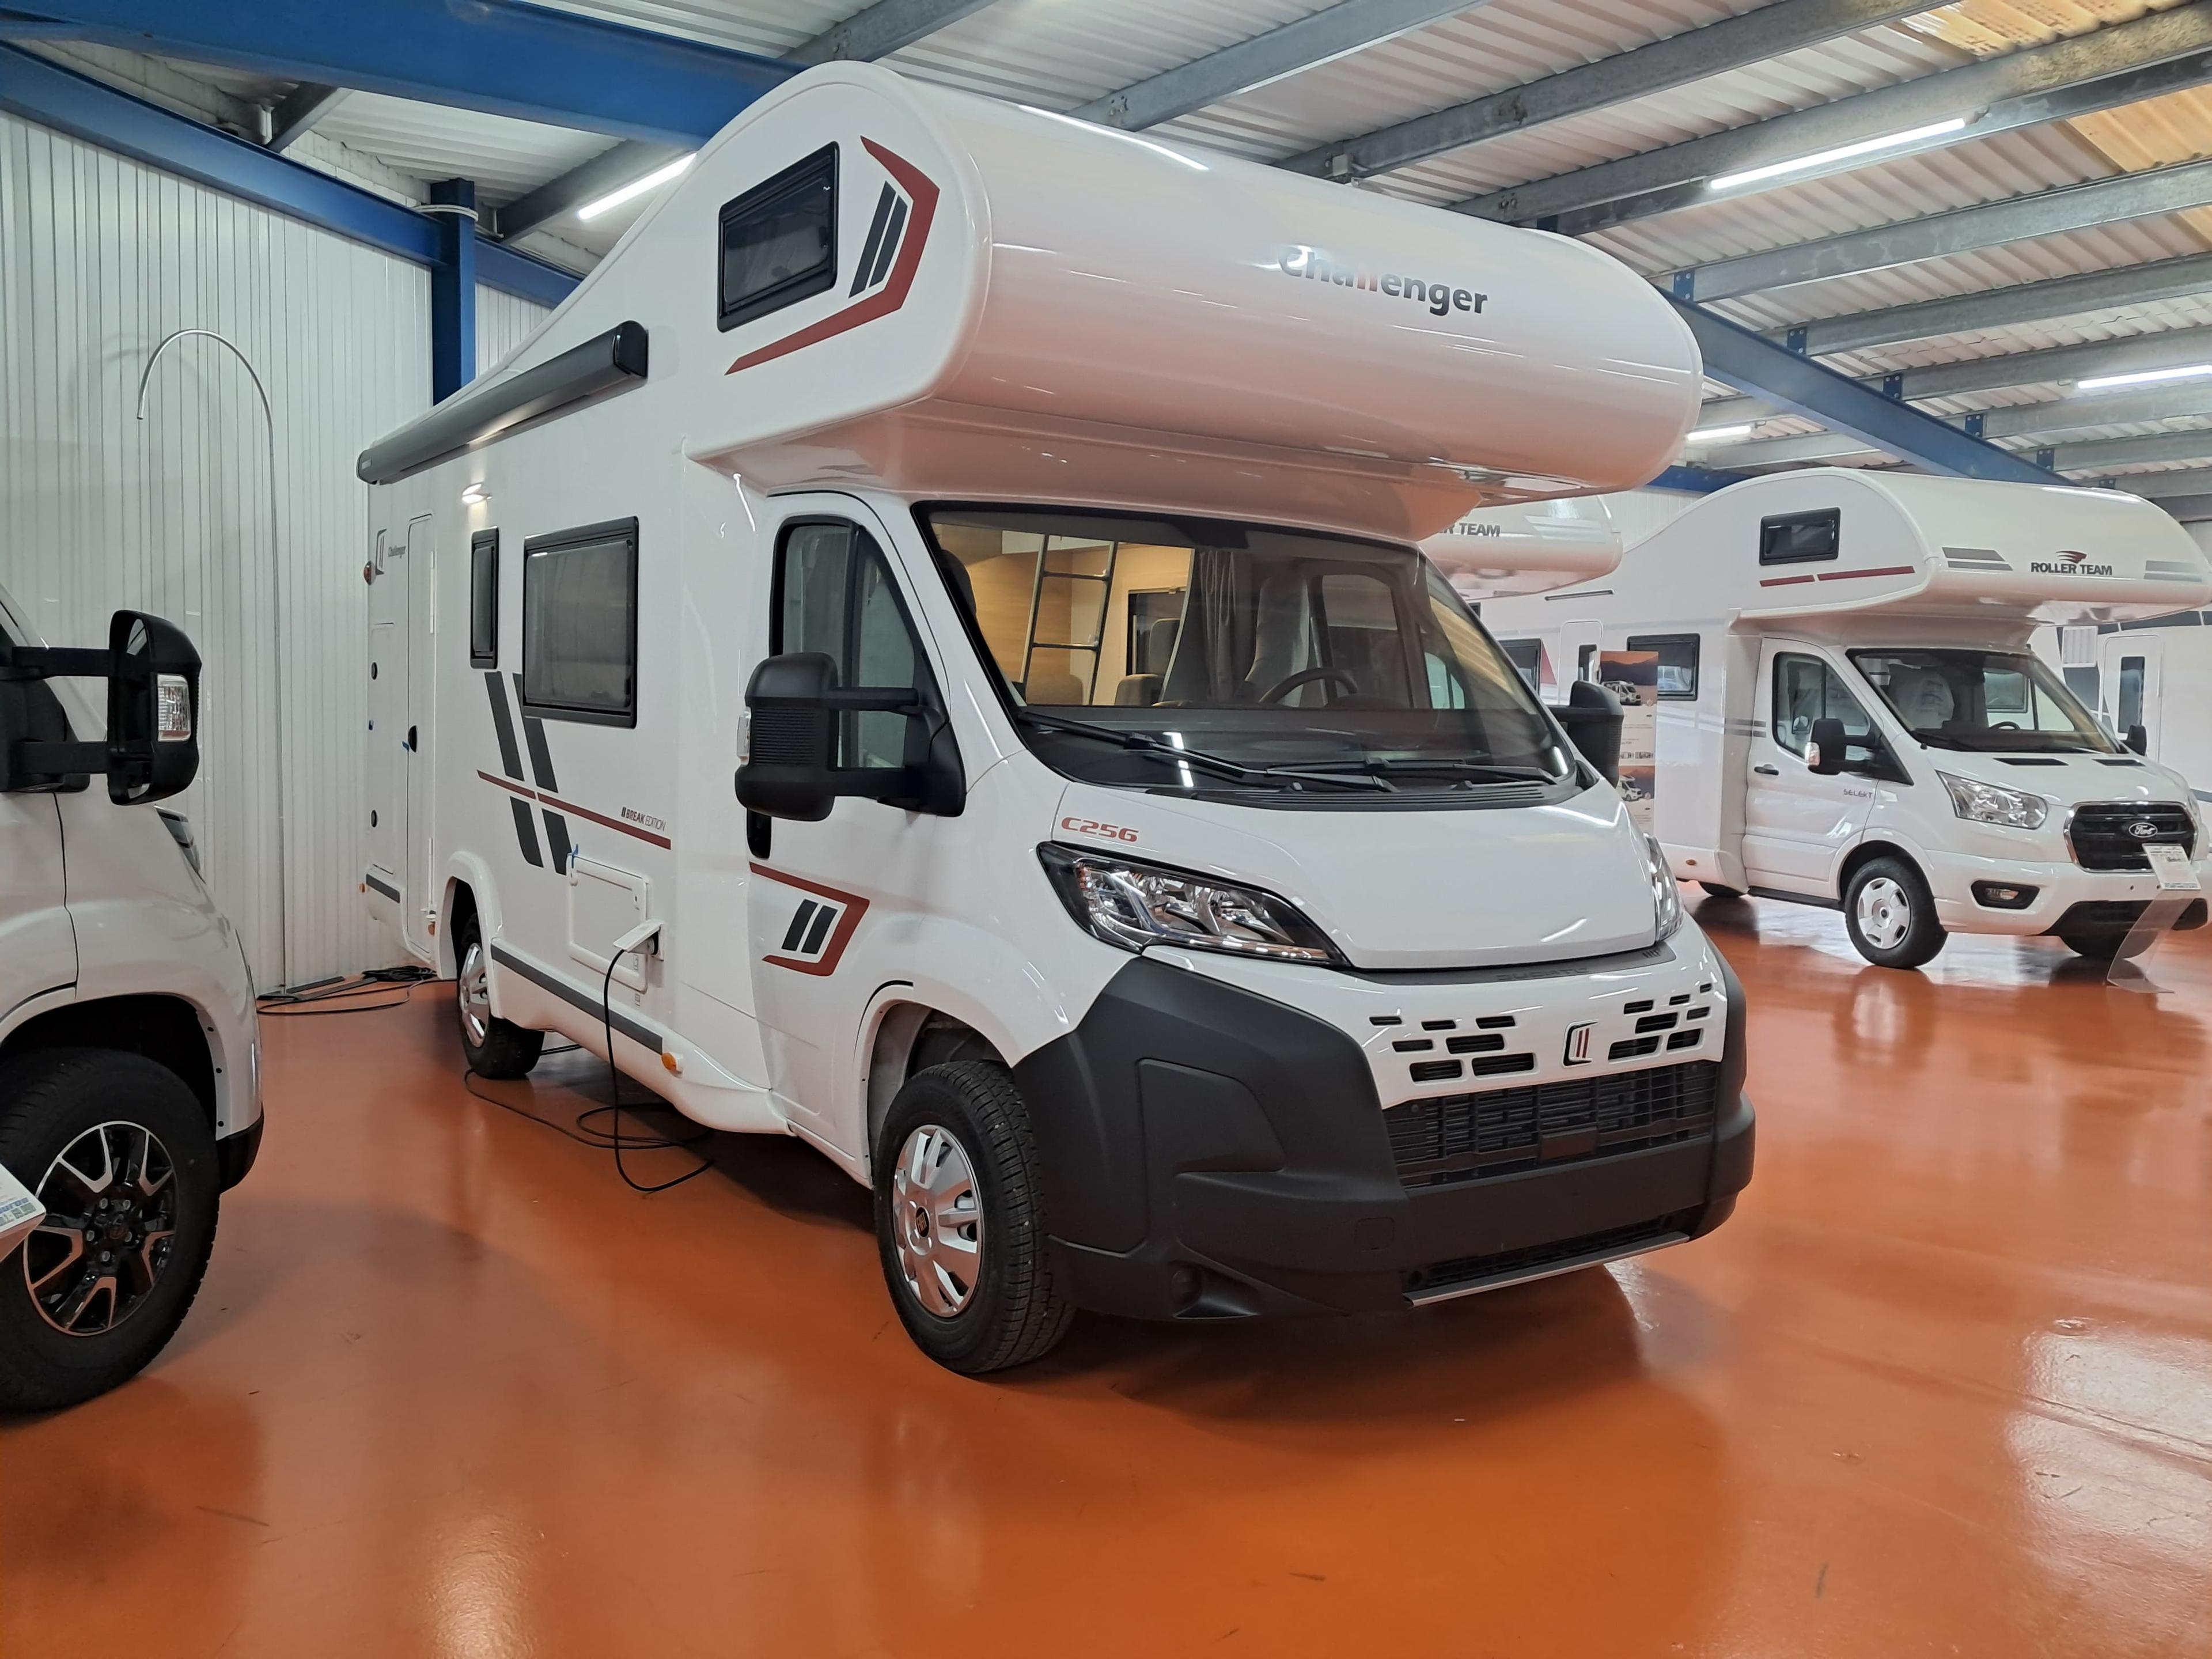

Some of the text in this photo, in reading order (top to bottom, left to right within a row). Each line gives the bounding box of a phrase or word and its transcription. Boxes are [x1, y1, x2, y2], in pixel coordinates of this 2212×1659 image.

[1278, 245, 1488, 316] Challenger
[1459, 522, 1501, 537] TEAM
[2031, 562, 2112, 575] ROLLER TEAM
[626, 809, 666, 831] BREAK EDITION
[1061, 817, 1139, 842] C256
